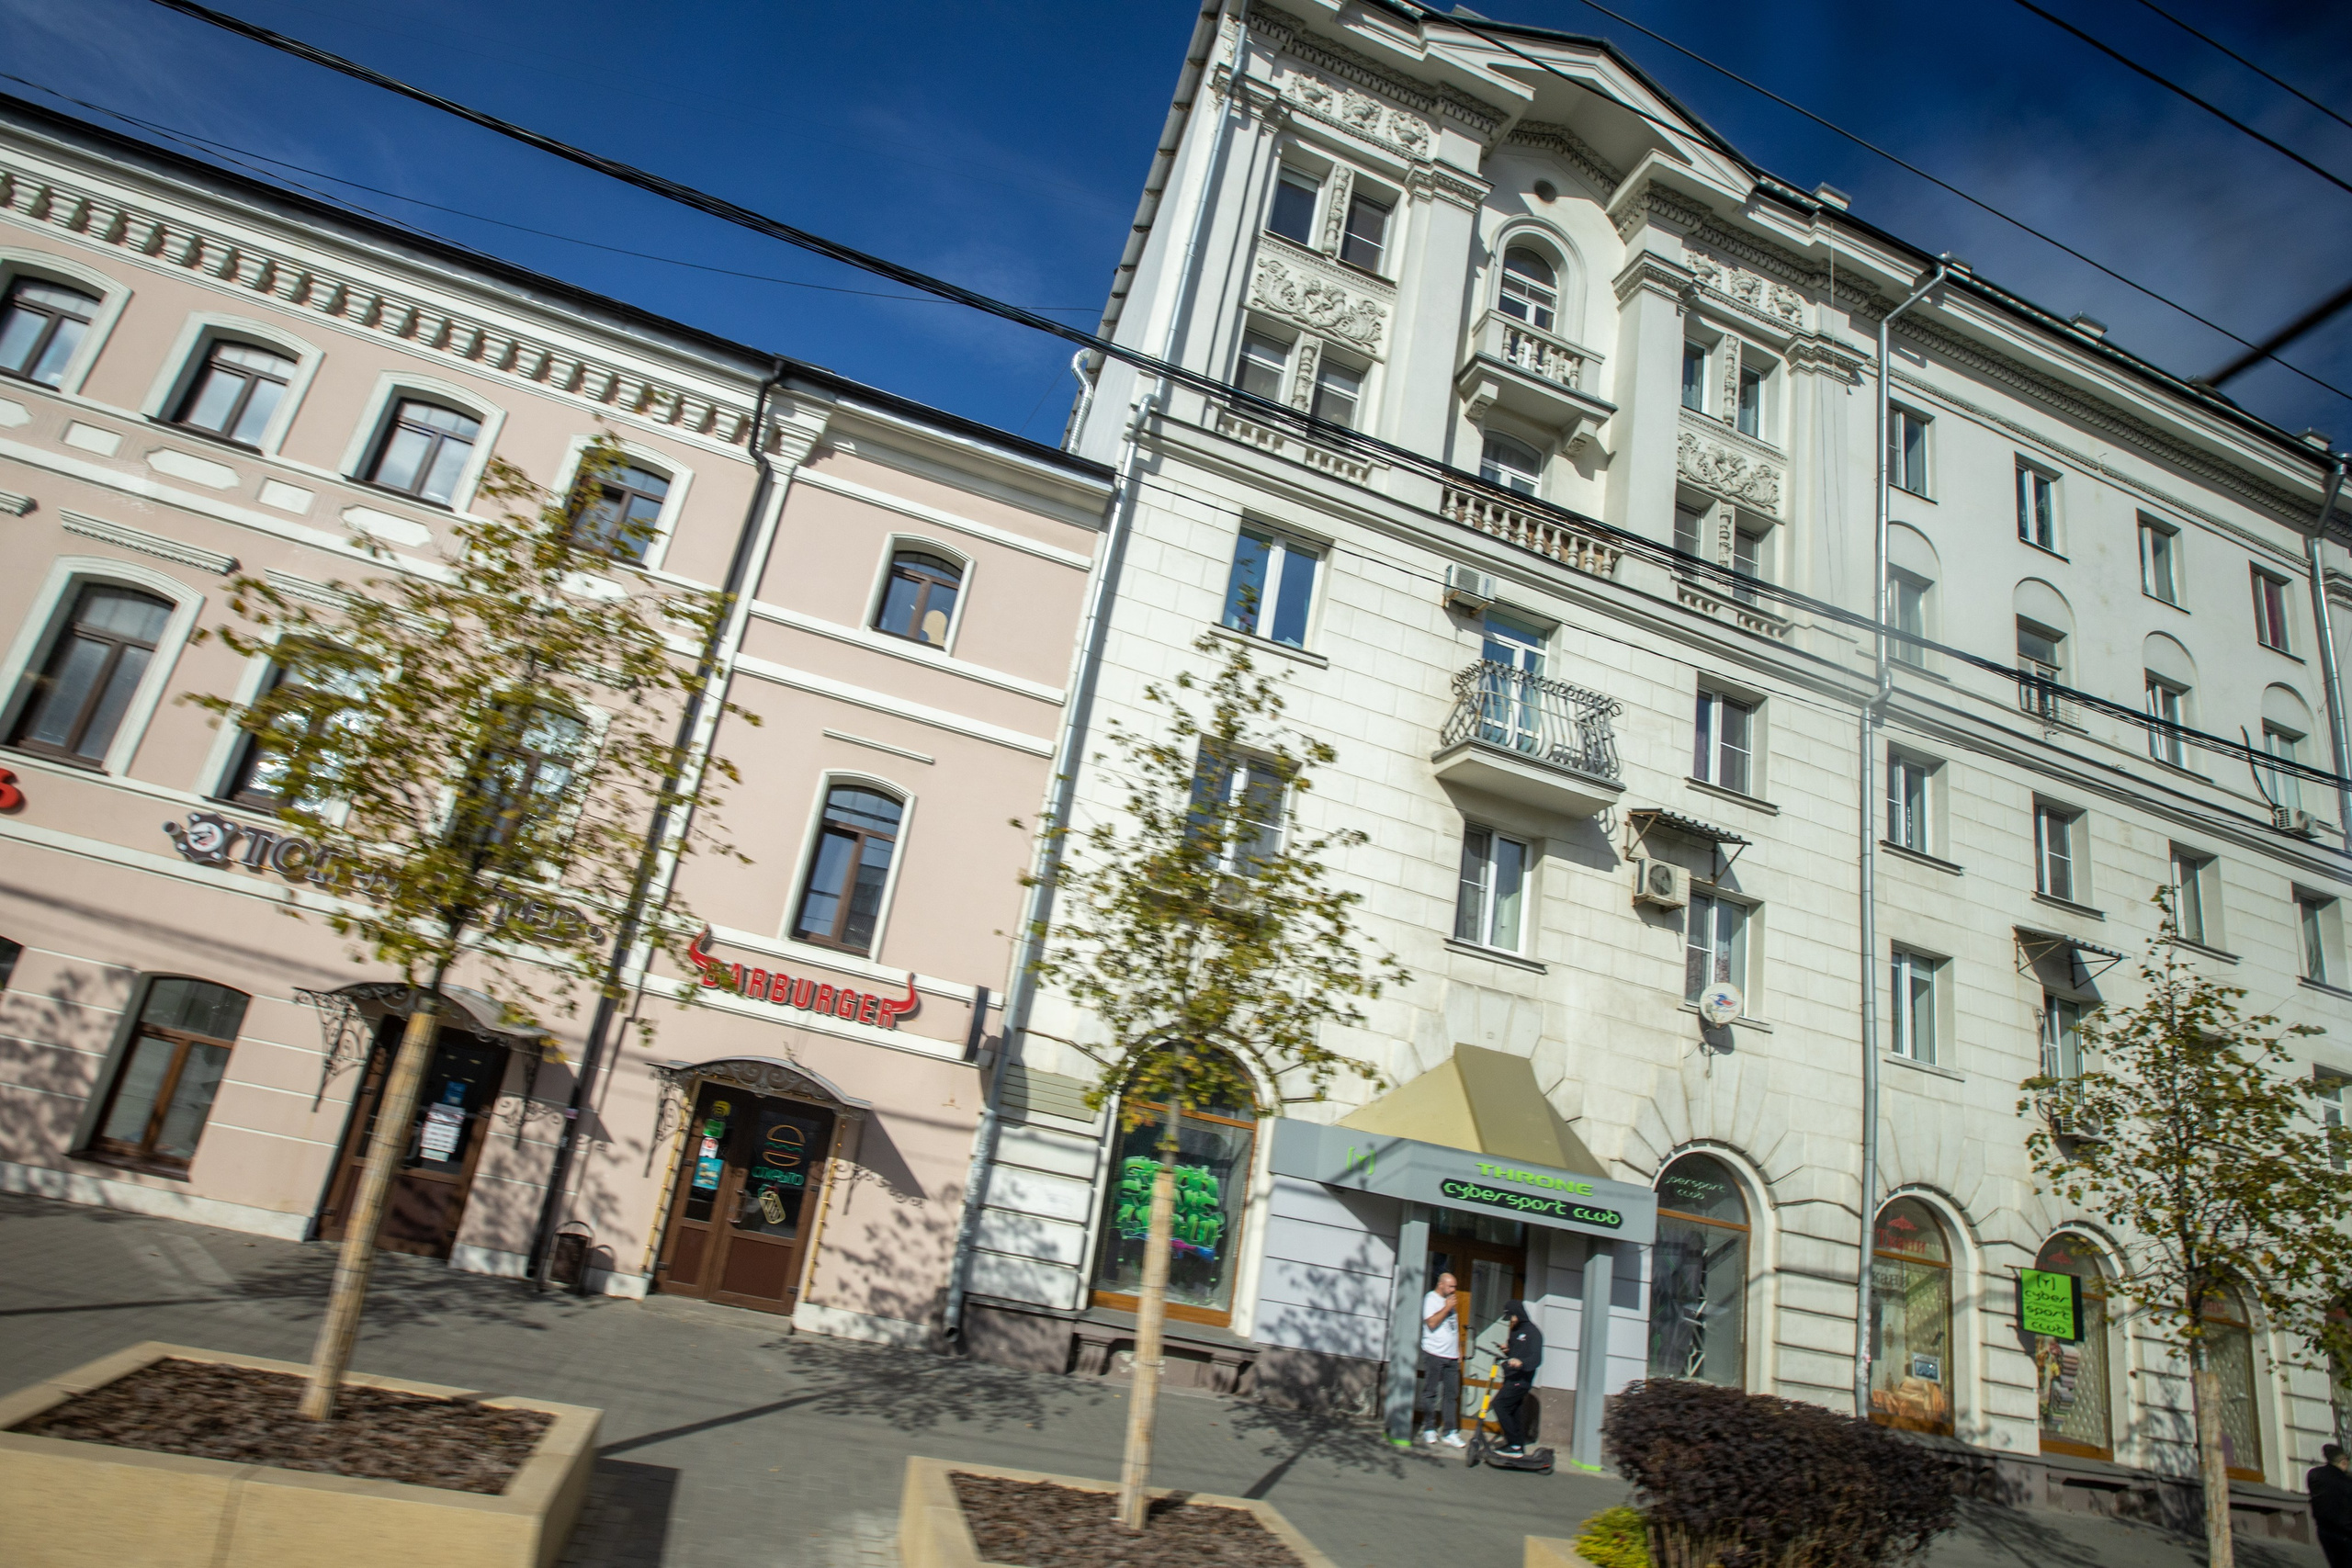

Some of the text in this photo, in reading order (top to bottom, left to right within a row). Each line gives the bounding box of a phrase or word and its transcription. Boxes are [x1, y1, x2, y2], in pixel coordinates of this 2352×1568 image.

[700, 958, 899, 1030] BARBURGER
[1476, 1162, 1594, 1196] THRONE
[1442, 1182, 1621, 1224] cybersport club
[1876, 1228, 1927, 1254] Ткани
[2024, 1290, 2070, 1303] cyber
[2026, 1305, 2070, 1320] sport
[2031, 1322, 2066, 1334] club
